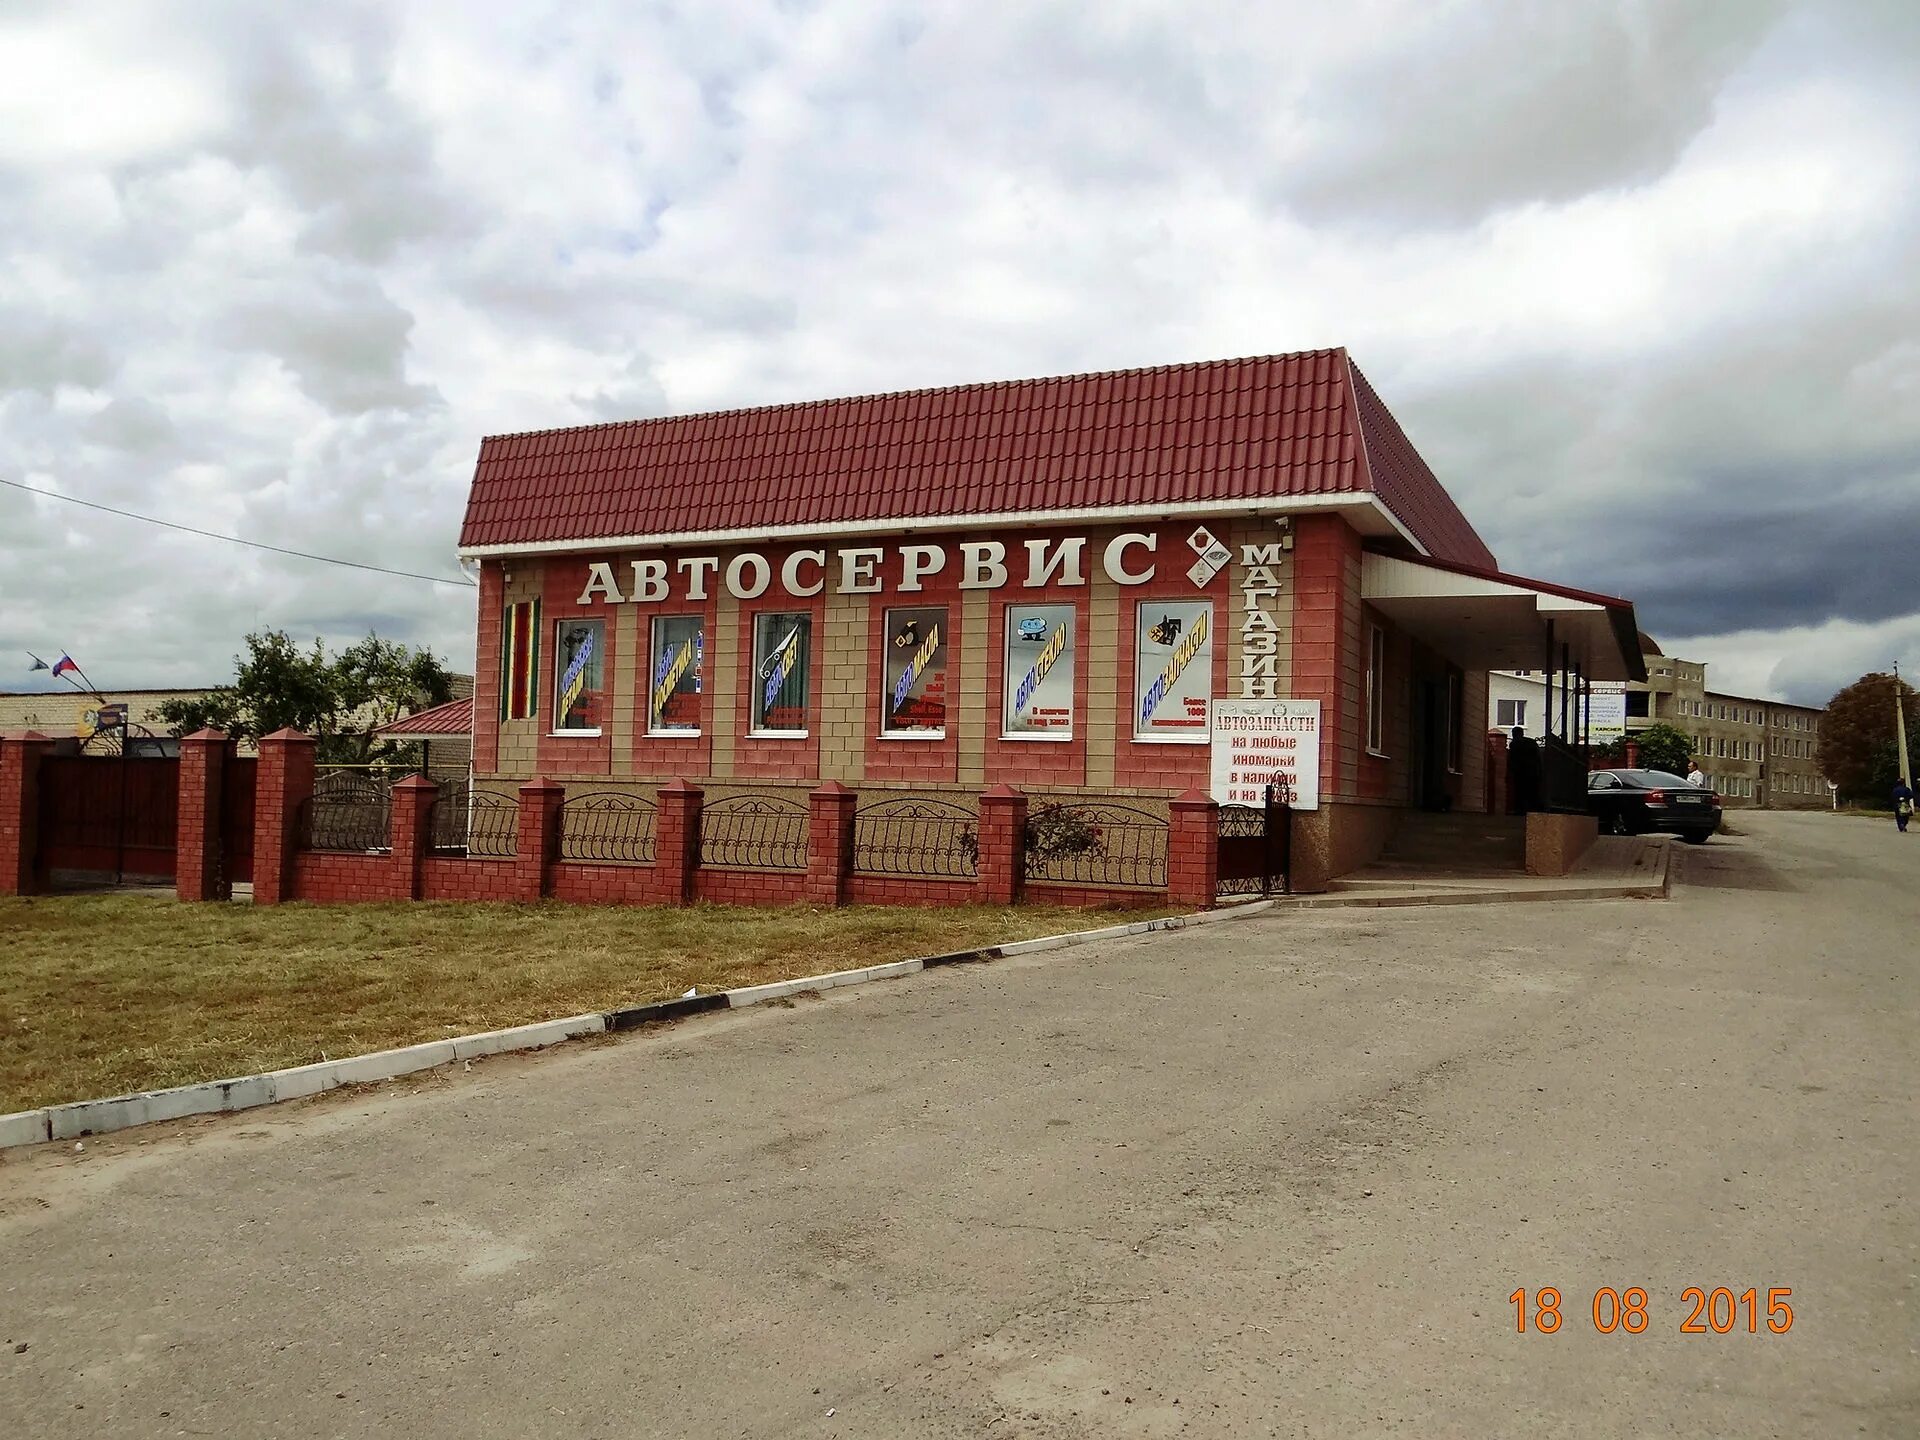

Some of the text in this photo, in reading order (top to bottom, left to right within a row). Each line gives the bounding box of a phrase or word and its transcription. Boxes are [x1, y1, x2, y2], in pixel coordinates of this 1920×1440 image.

[576, 532, 1158, 606] АВТОСЕРВИС
[1239, 543, 1282, 699] МАГАЗИН
[1186, 707, 1207, 716] 1000
[1215, 715, 1315, 732] АВТОЗАПЧАСТИ
[1231, 735, 1297, 749] на любые
[1232, 754, 1296, 767] иномарки
[1230, 772, 1238, 783] в
[1229, 790, 1237, 801] и
[1242, 790, 1256, 801] на
